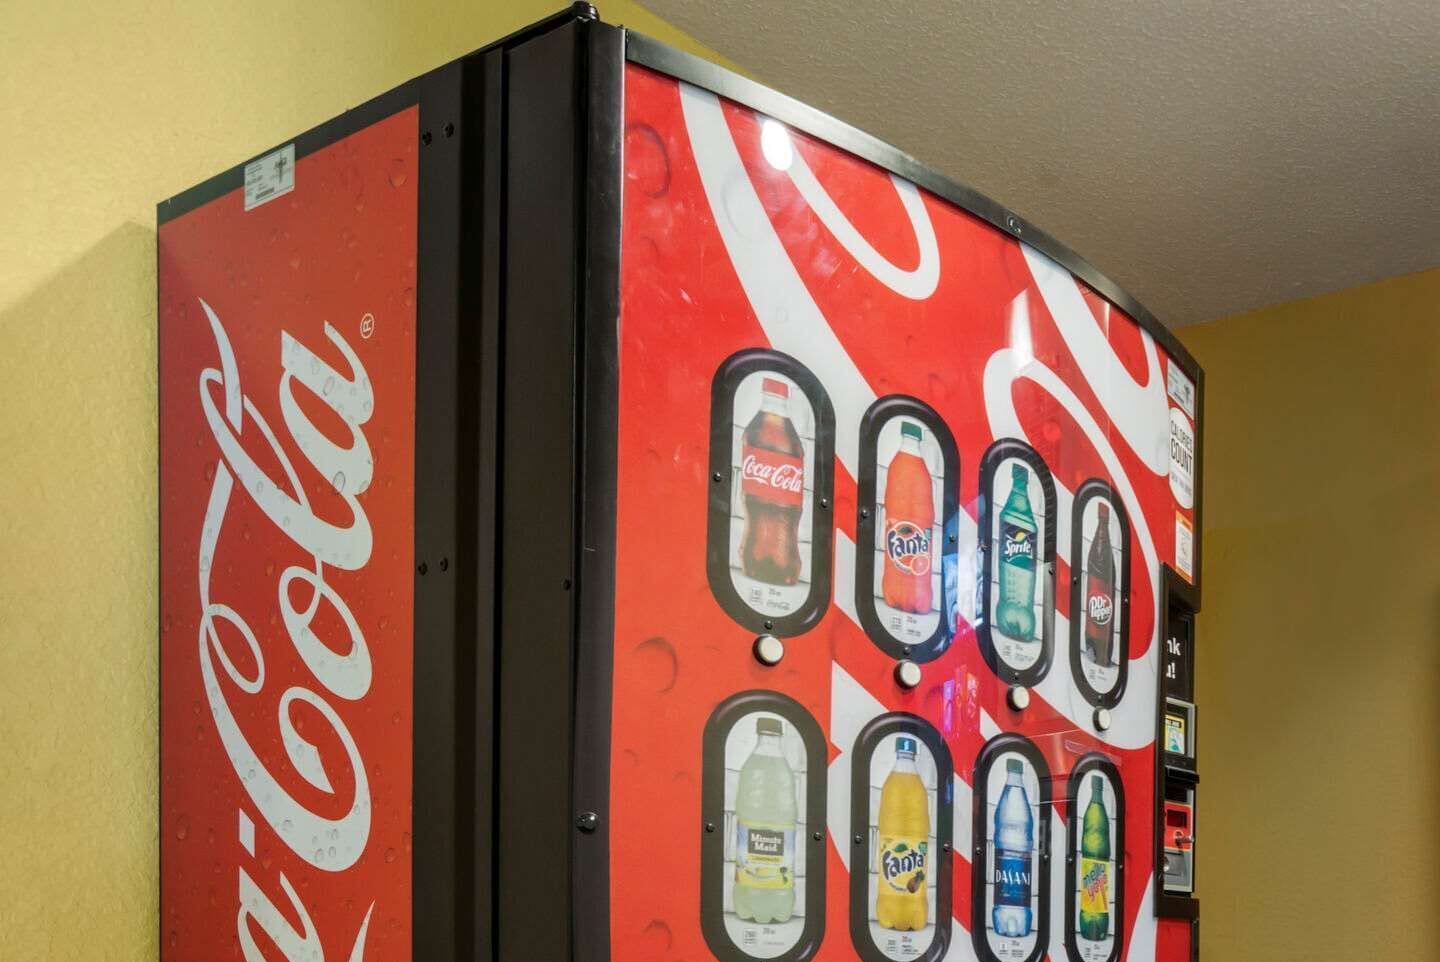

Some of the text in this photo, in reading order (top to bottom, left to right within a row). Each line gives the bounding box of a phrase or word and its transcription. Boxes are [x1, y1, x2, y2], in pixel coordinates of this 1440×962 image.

[1170, 438, 1192, 476] COUNT
[742, 454, 802, 493] Coca-Cola
[887, 530, 928, 559] Fanta
[1004, 540, 1032, 556] Sprite
[754, 842, 778, 852] Maid
[882, 849, 926, 881] Fanta
[995, 866, 1031, 886] DASANI
